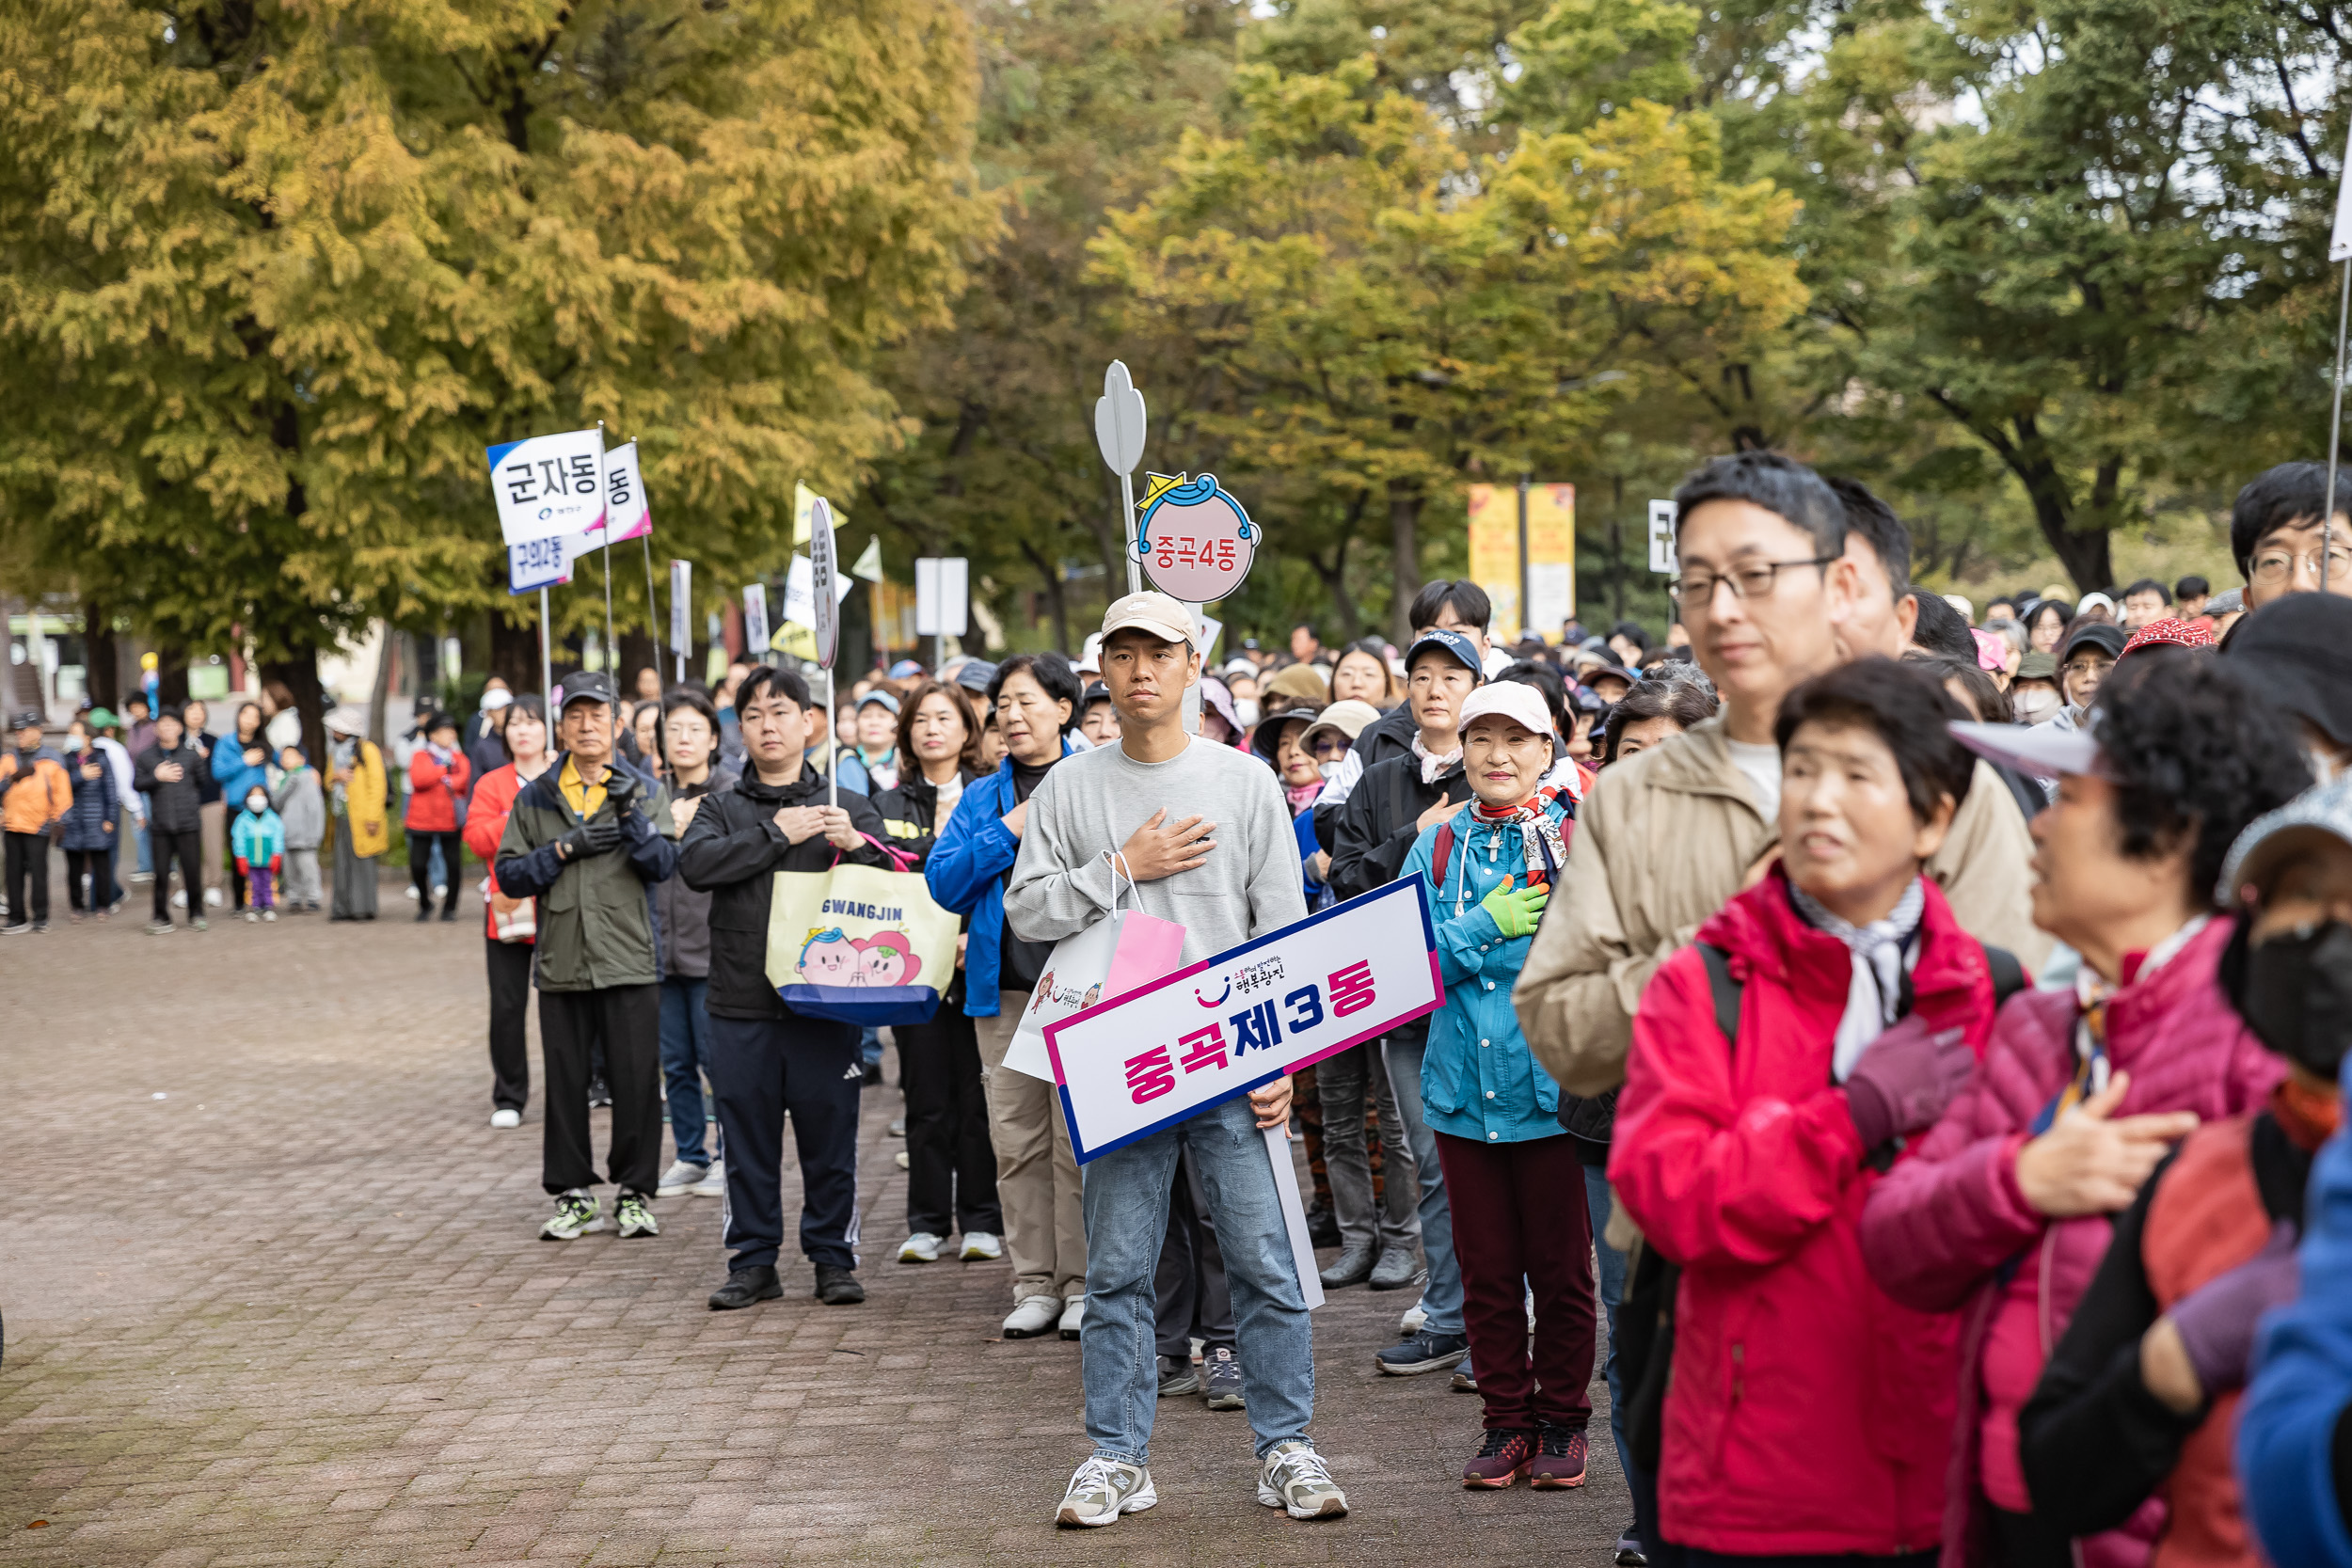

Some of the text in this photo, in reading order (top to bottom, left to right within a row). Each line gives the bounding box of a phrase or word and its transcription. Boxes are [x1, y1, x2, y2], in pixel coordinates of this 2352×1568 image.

[506, 454, 596, 504] 군자동
[609, 468, 630, 505] 동
[517, 536, 563, 576] 구의2동
[1156, 536, 1236, 572] 중곡4동
[821, 899, 902, 921] GWANGJIN
[1234, 955, 1281, 979] 소통하며 발전하는
[1236, 964, 1285, 994] 행복광진
[1113, 1473, 1131, 1490] N
